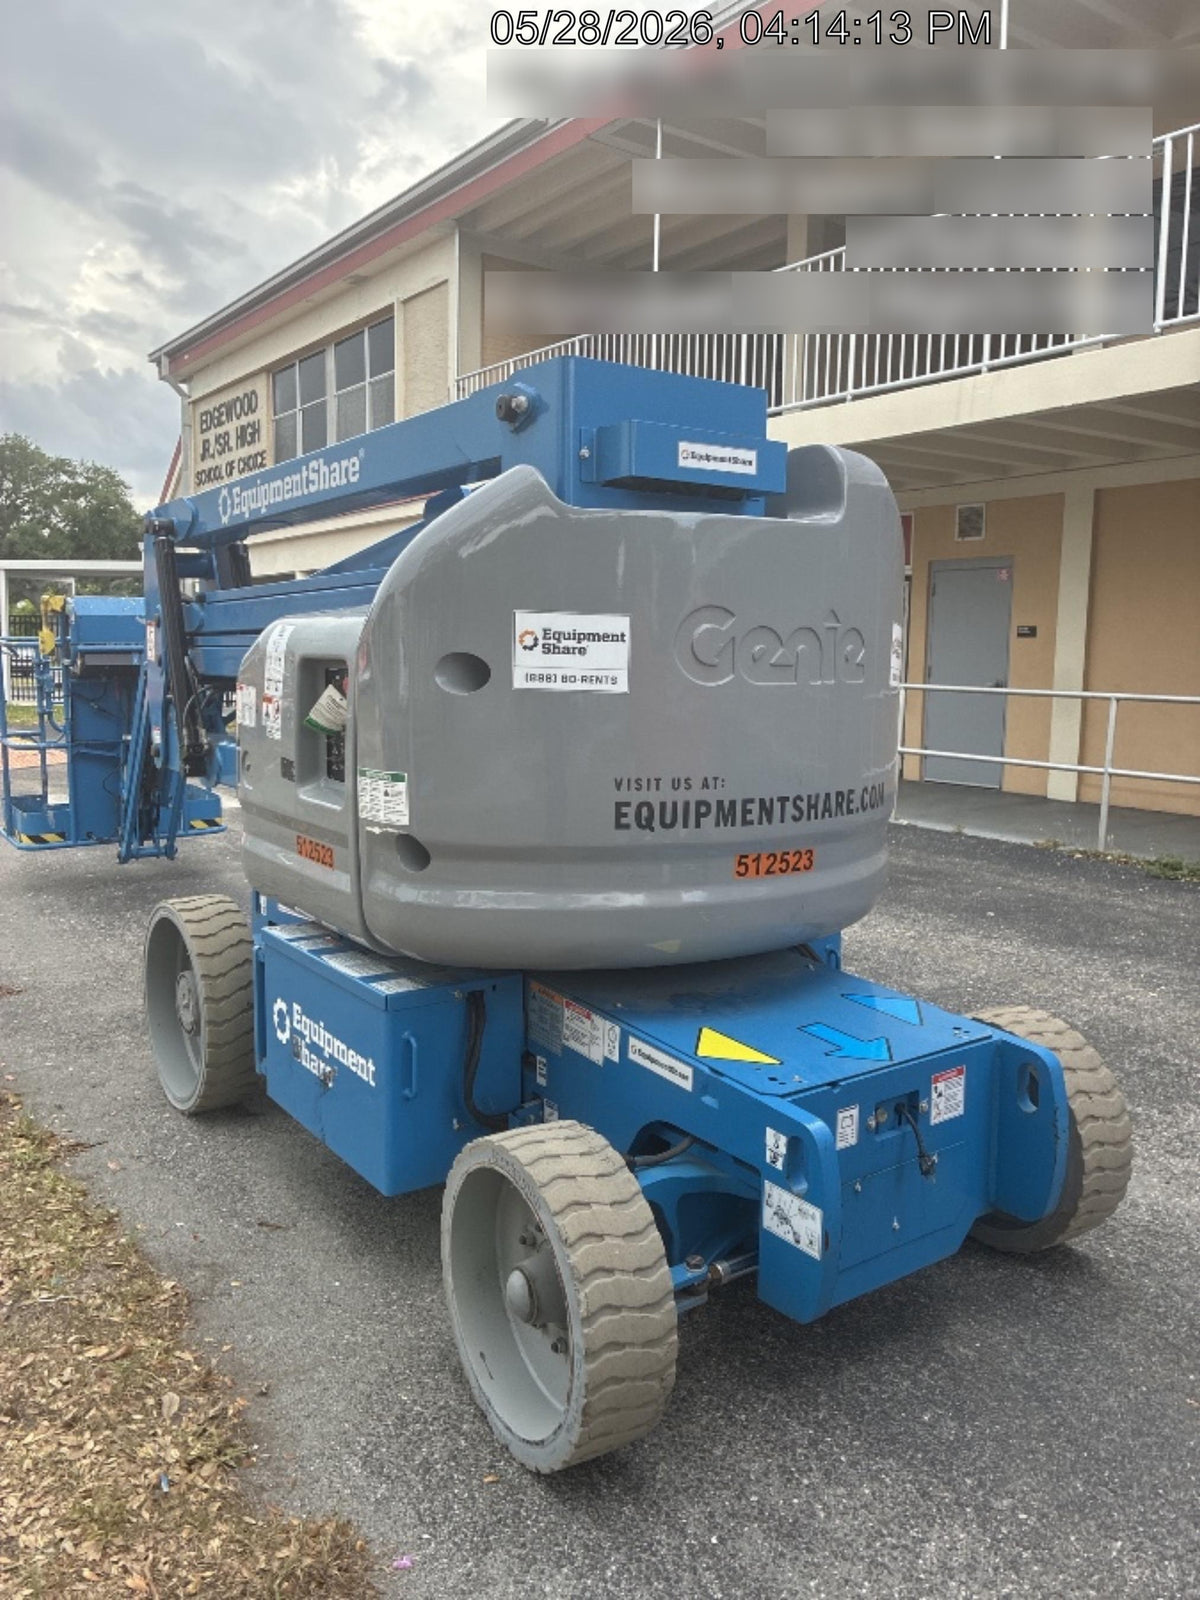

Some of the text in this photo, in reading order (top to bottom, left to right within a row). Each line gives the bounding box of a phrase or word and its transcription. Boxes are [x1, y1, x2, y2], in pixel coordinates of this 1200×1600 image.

[200, 389, 258, 434] EDGEWOOD
[236, 419, 260, 450] HIGH
[195, 449, 267, 486] SCHOOL OF CHOICE
[541, 627, 626, 644] Equipment
[541, 643, 587, 656] Share
[674, 604, 865, 686] Genie
[614, 777, 726, 791] VISIT US AT:
[614, 782, 885, 832] EQUIPMENTSHARE.COM
[735, 849, 813, 877] 512523
[292, 1002, 376, 1088] Equipment
